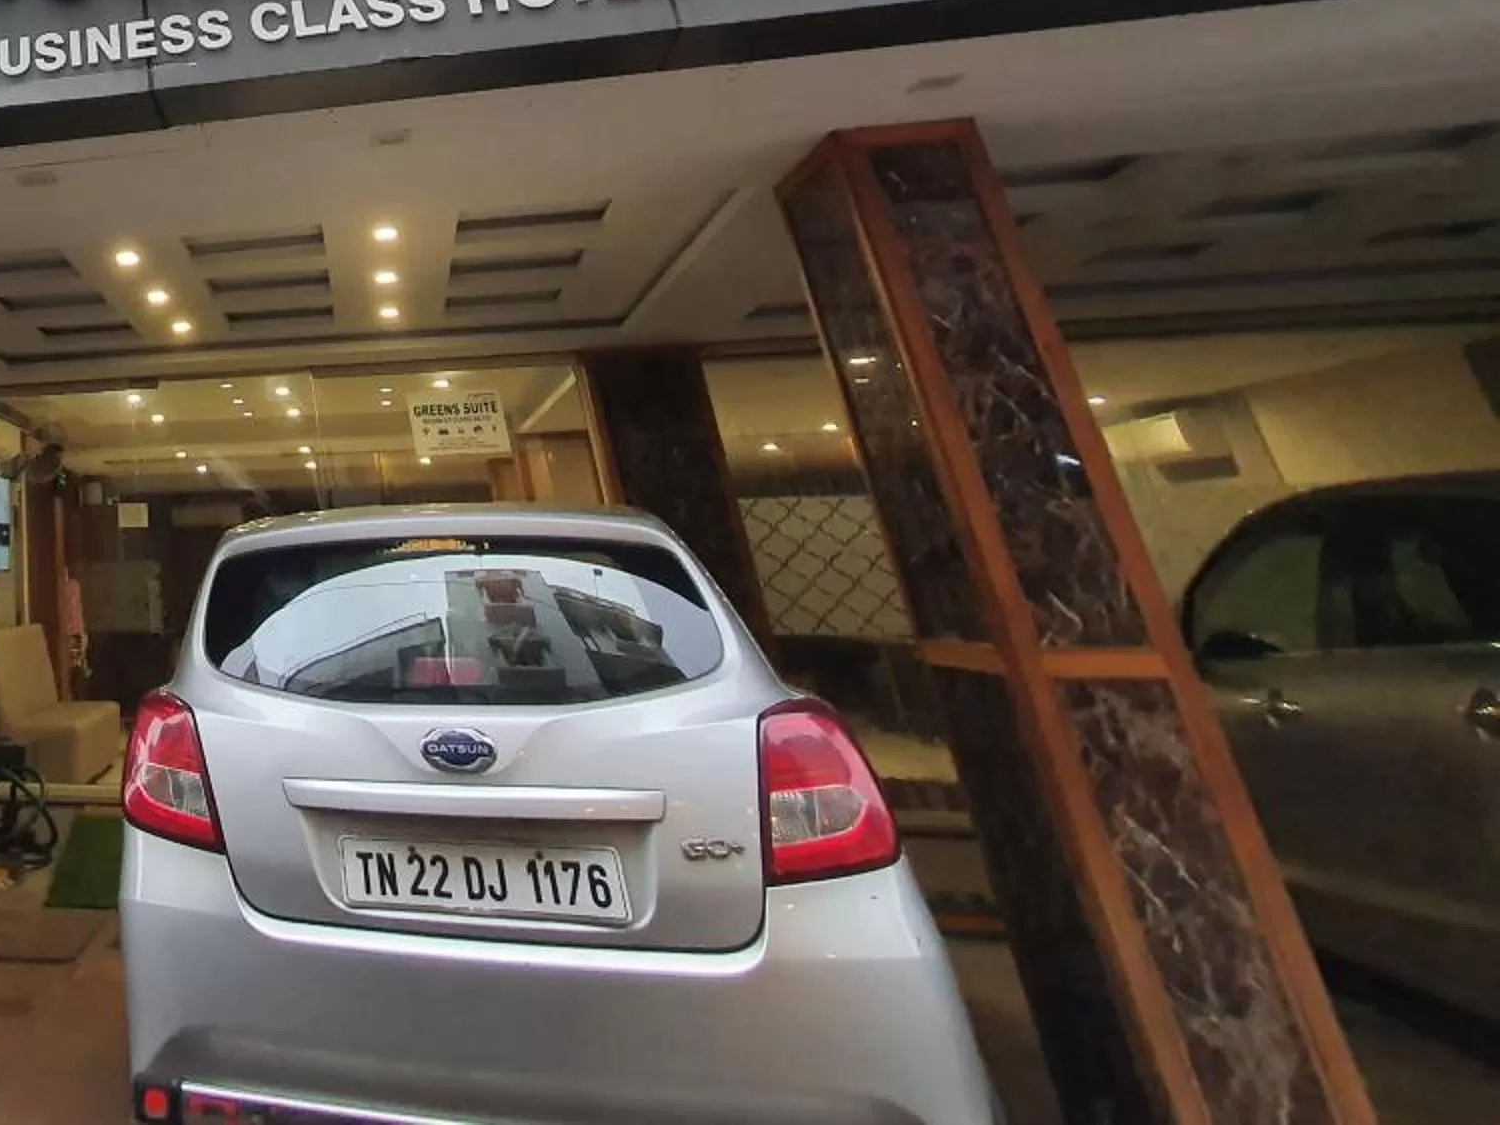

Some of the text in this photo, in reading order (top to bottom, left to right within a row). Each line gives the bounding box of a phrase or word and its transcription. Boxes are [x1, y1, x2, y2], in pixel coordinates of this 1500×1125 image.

[463, 401, 497, 414] SUITE
[427, 743, 488, 755] DATSUN
[356, 851, 612, 908] TN 22 DJ 1176
